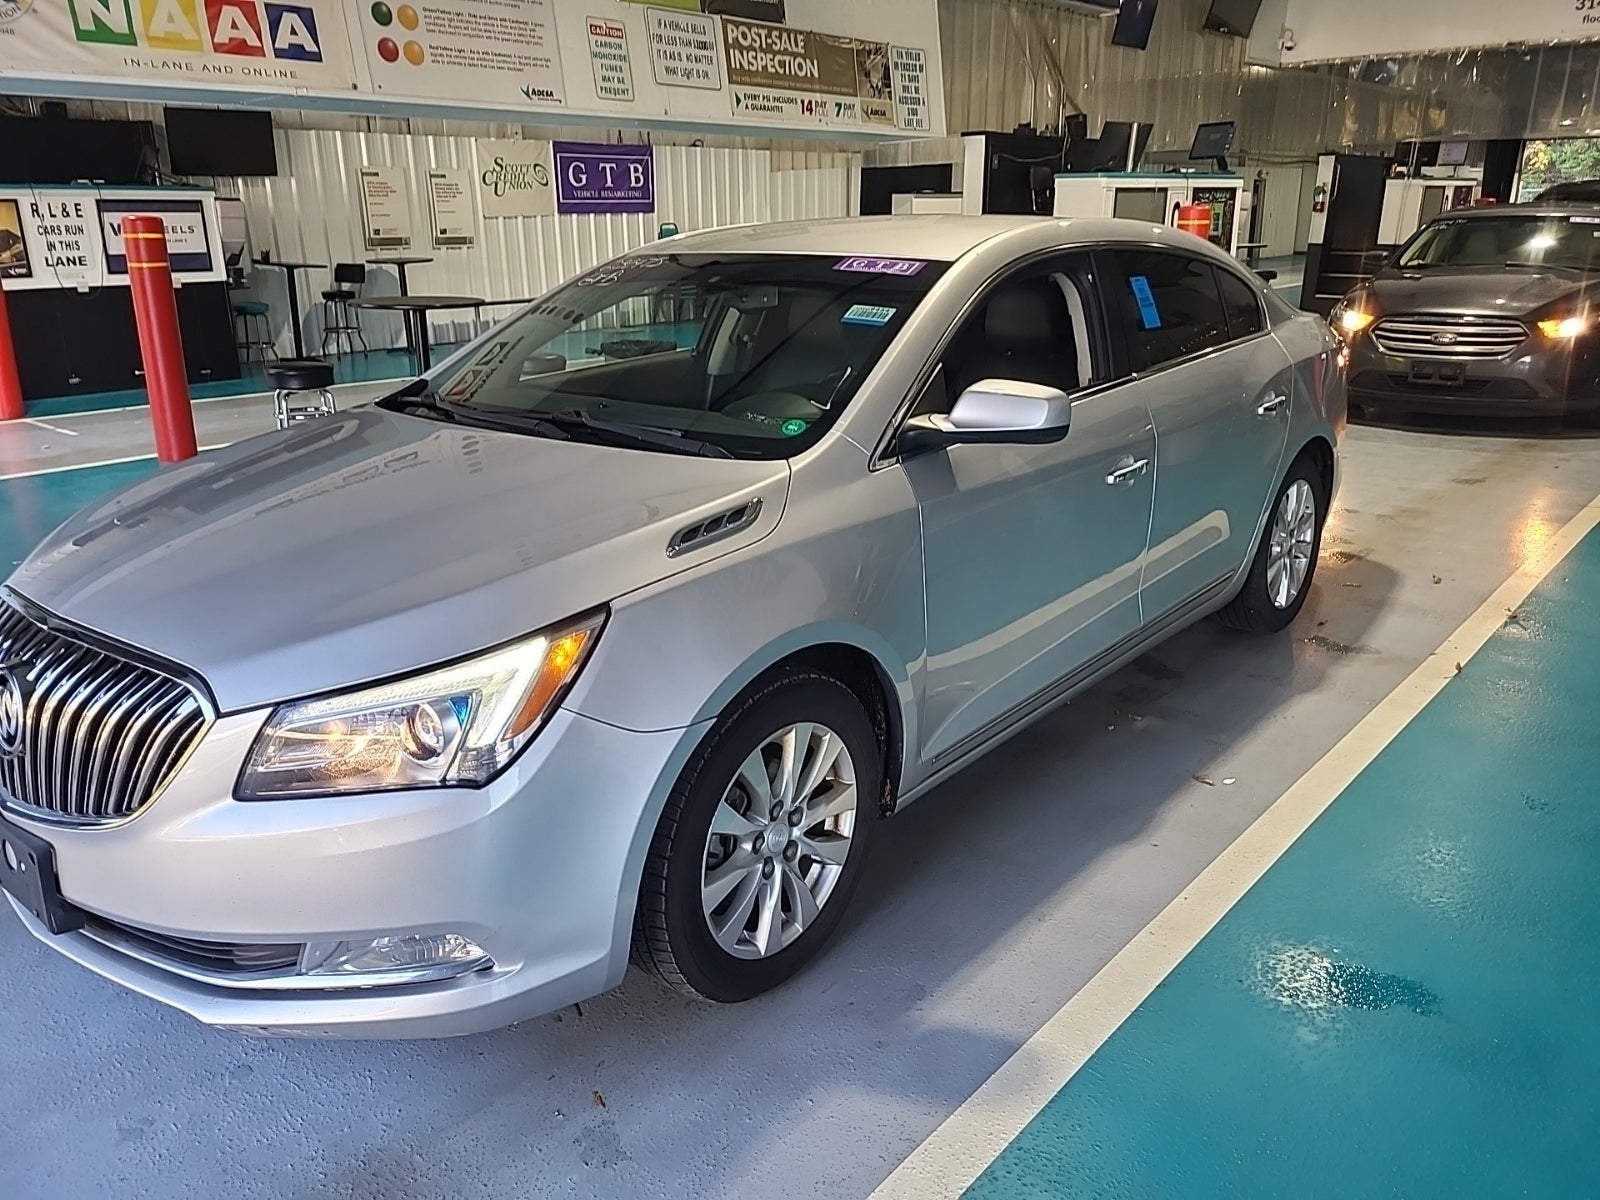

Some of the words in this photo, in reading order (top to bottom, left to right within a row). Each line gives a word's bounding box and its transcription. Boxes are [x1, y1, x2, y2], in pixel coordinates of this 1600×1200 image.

[591, 26, 623, 38] CAUTION
[691, 23, 706, 36] SELLS
[652, 33, 663, 44] FOR
[664, 35, 677, 47] LESS
[678, 36, 692, 49] THAN
[727, 23, 804, 54] POST-SALE
[594, 40, 623, 51] CARBON
[592, 51, 627, 62] MONOXIDE
[694, 53, 713, 65] MATTER
[123, 57, 194, 73] IN-LANE
[201, 64, 233, 75] AND
[241, 68, 299, 80] ONLINE
[600, 63, 623, 73] FUMES
[730, 48, 819, 78] INSPECTION
[664, 65, 678, 76] WHAT
[680, 67, 694, 78] LIGHT
[601, 75, 615, 83] MAY
[600, 86, 629, 97] PRESENT
[743, 92, 760, 102] EVERY
[772, 95, 797, 105] INCLUDES
[745, 102, 750, 111] A
[750, 103, 783, 113] GUARANTEE
[801, 99, 813, 115] 14
[835, 102, 842, 117] 7
[48, 202, 57, 218] L
[61, 202, 70, 218] &
[74, 202, 84, 218] E
[37, 224, 62, 236] CARS
[64, 224, 84, 236] RUN
[46, 240, 56, 251] IN
[58, 240, 81, 251] THIS
[44, 255, 88, 267] LANE
